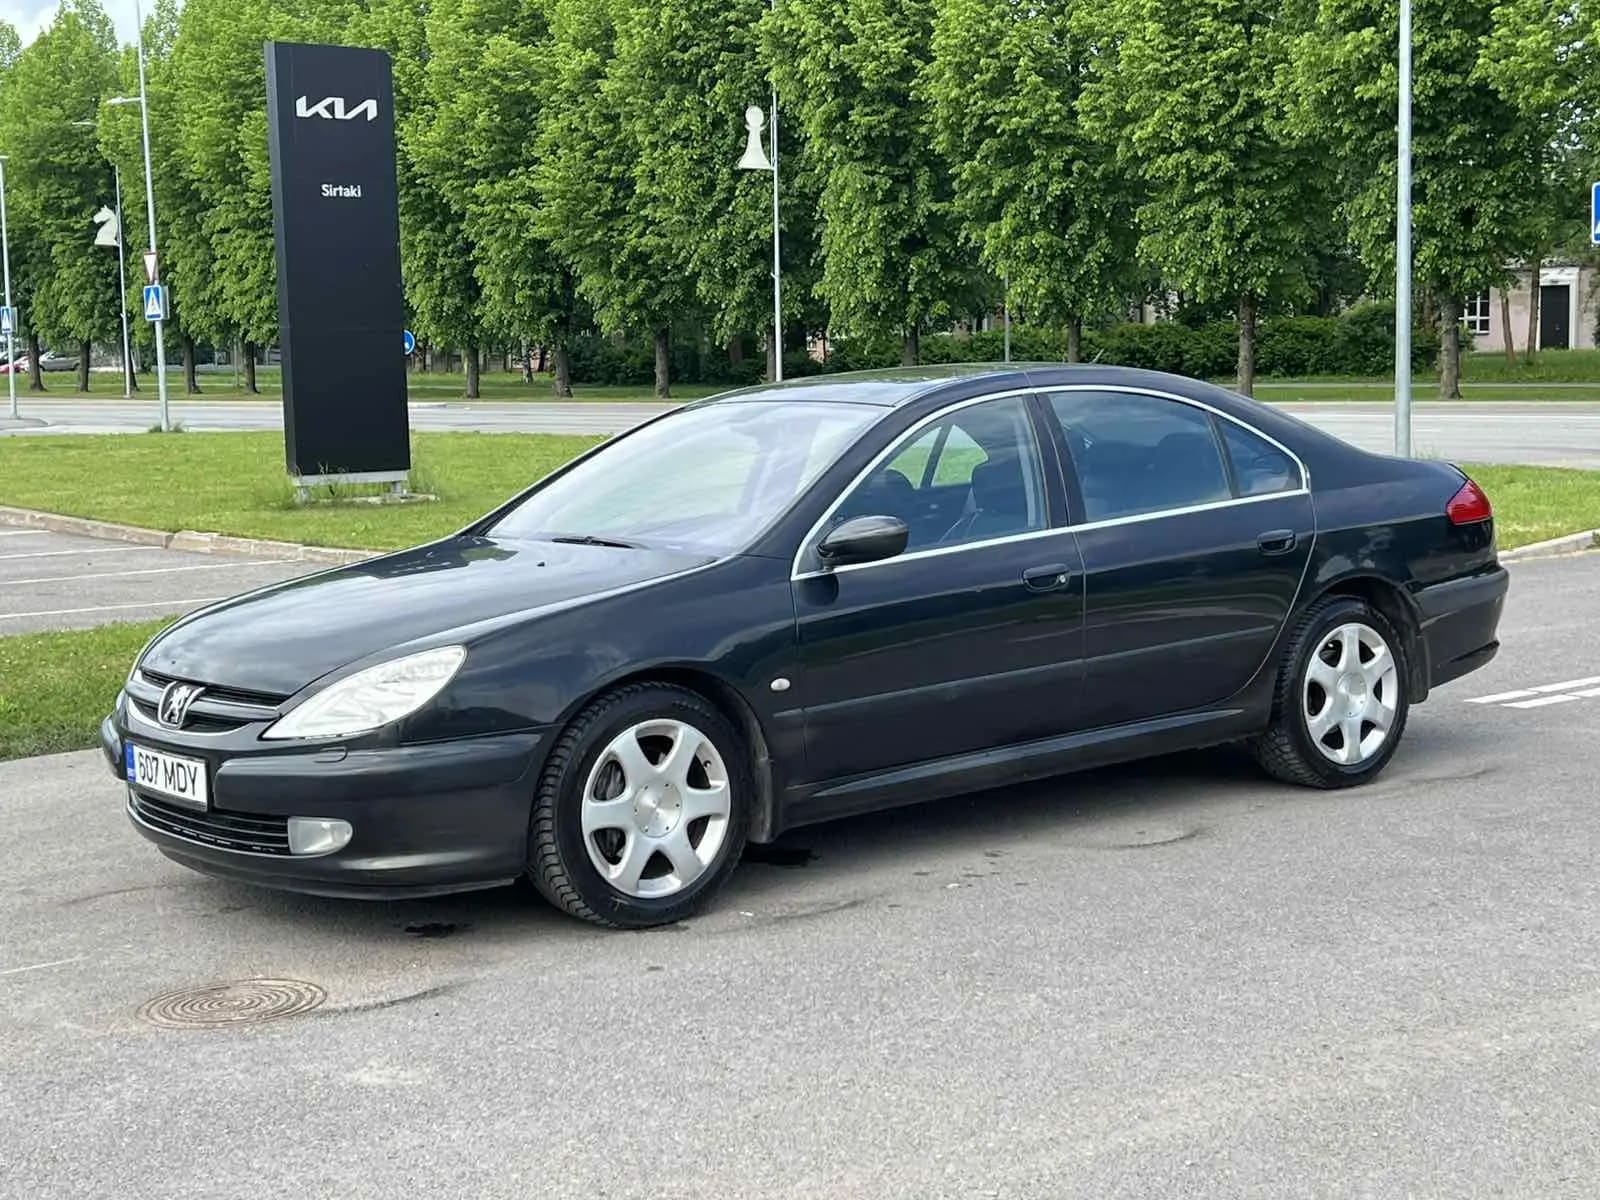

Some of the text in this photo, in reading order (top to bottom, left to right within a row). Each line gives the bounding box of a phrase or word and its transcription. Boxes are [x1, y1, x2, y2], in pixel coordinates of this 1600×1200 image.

[295, 95, 378, 121] KIA
[321, 183, 361, 198] Sirtaki
[138, 751, 198, 796] 607 MDY
